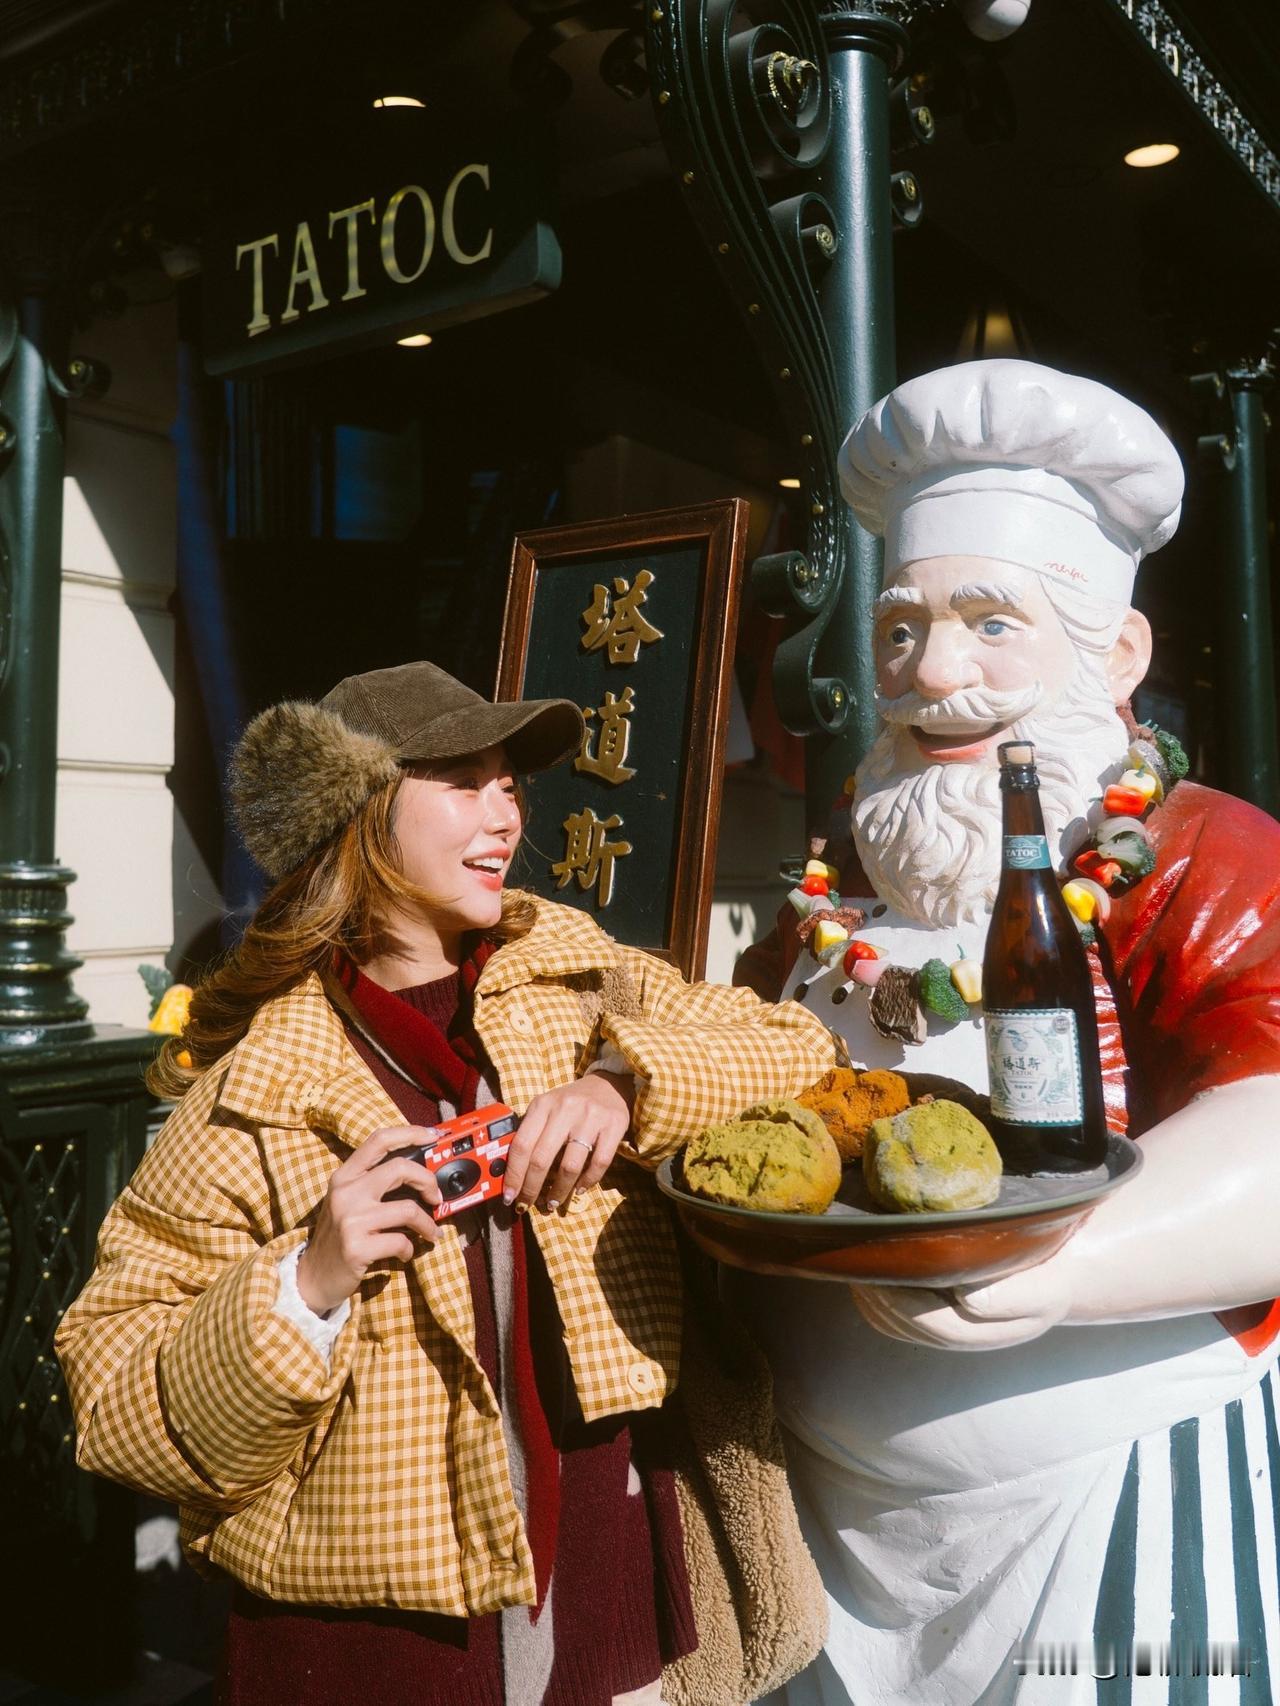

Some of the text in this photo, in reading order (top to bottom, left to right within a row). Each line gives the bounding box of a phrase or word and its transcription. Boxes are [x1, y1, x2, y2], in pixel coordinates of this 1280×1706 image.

[236, 163, 493, 334] TATOC
[552, 569, 665, 908] 塔道斯
[1005, 848, 1038, 857] TATOC
